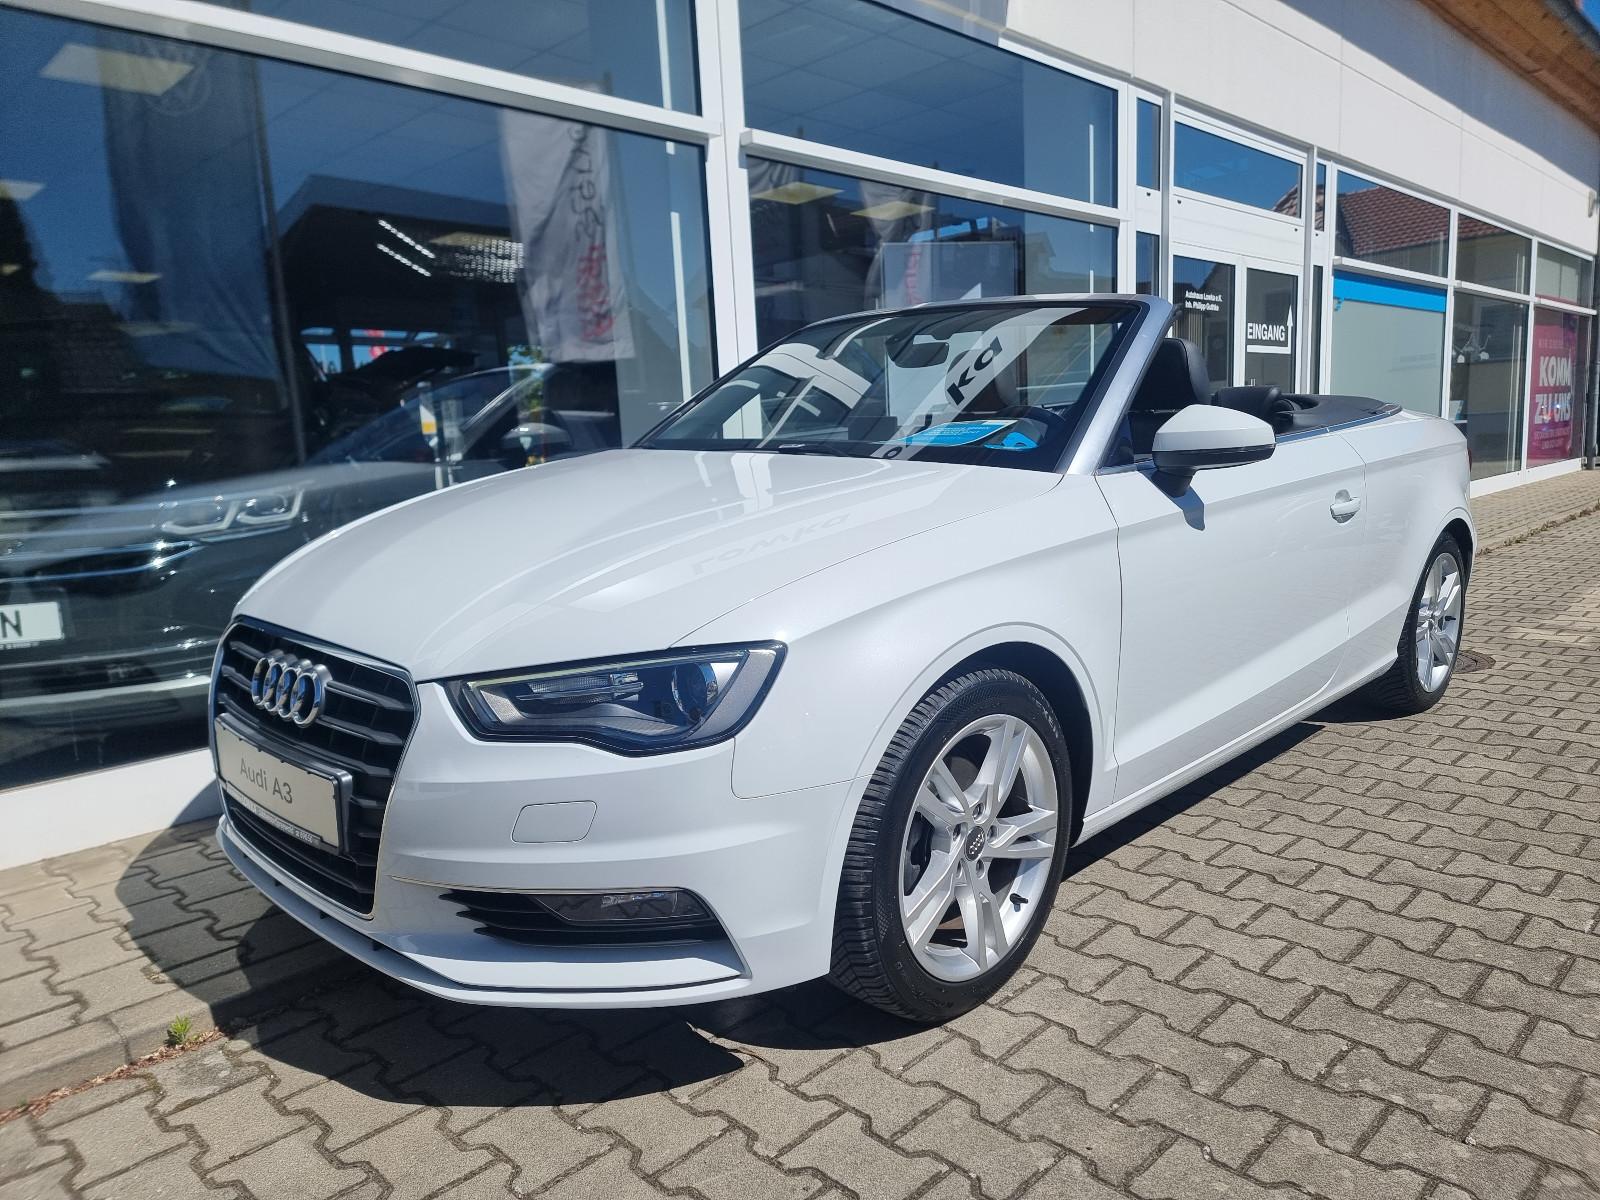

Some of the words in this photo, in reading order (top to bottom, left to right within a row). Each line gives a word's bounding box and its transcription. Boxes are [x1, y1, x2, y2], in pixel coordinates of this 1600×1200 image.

[1247, 322, 1286, 341] EINGANG
[1539, 355, 1571, 388] KOMM
[240, 758, 268, 791] Audi
[272, 777, 293, 804] A3
